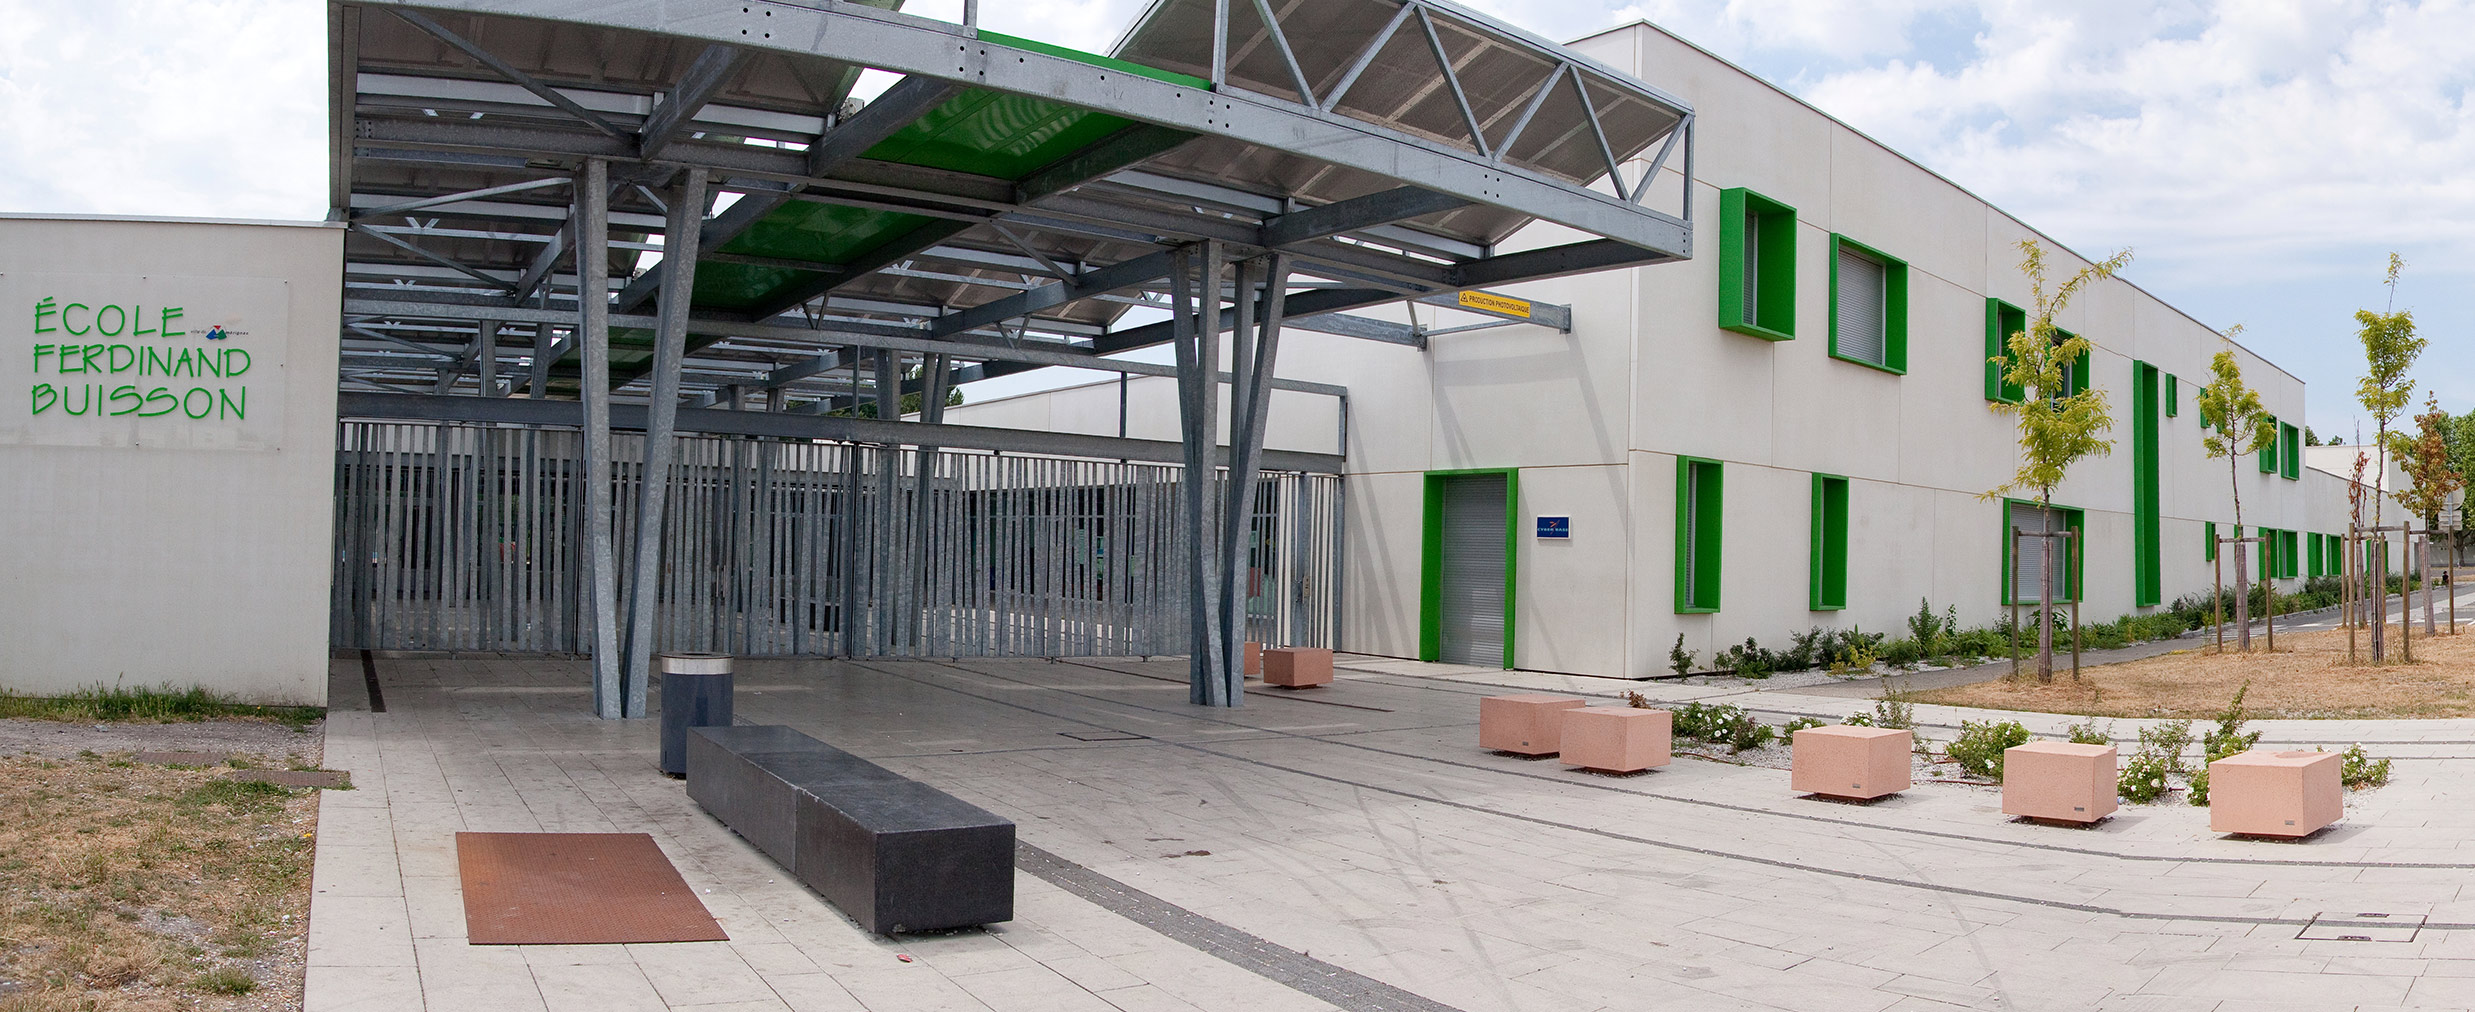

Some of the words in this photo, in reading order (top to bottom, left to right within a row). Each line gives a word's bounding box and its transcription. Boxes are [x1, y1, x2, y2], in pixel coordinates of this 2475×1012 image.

[34, 296, 186, 338] ÉCOLE
[1469, 295, 1495, 306] PRODUCTION
[33, 343, 251, 379] FERDINAND
[32, 383, 246, 420] BUISSON
